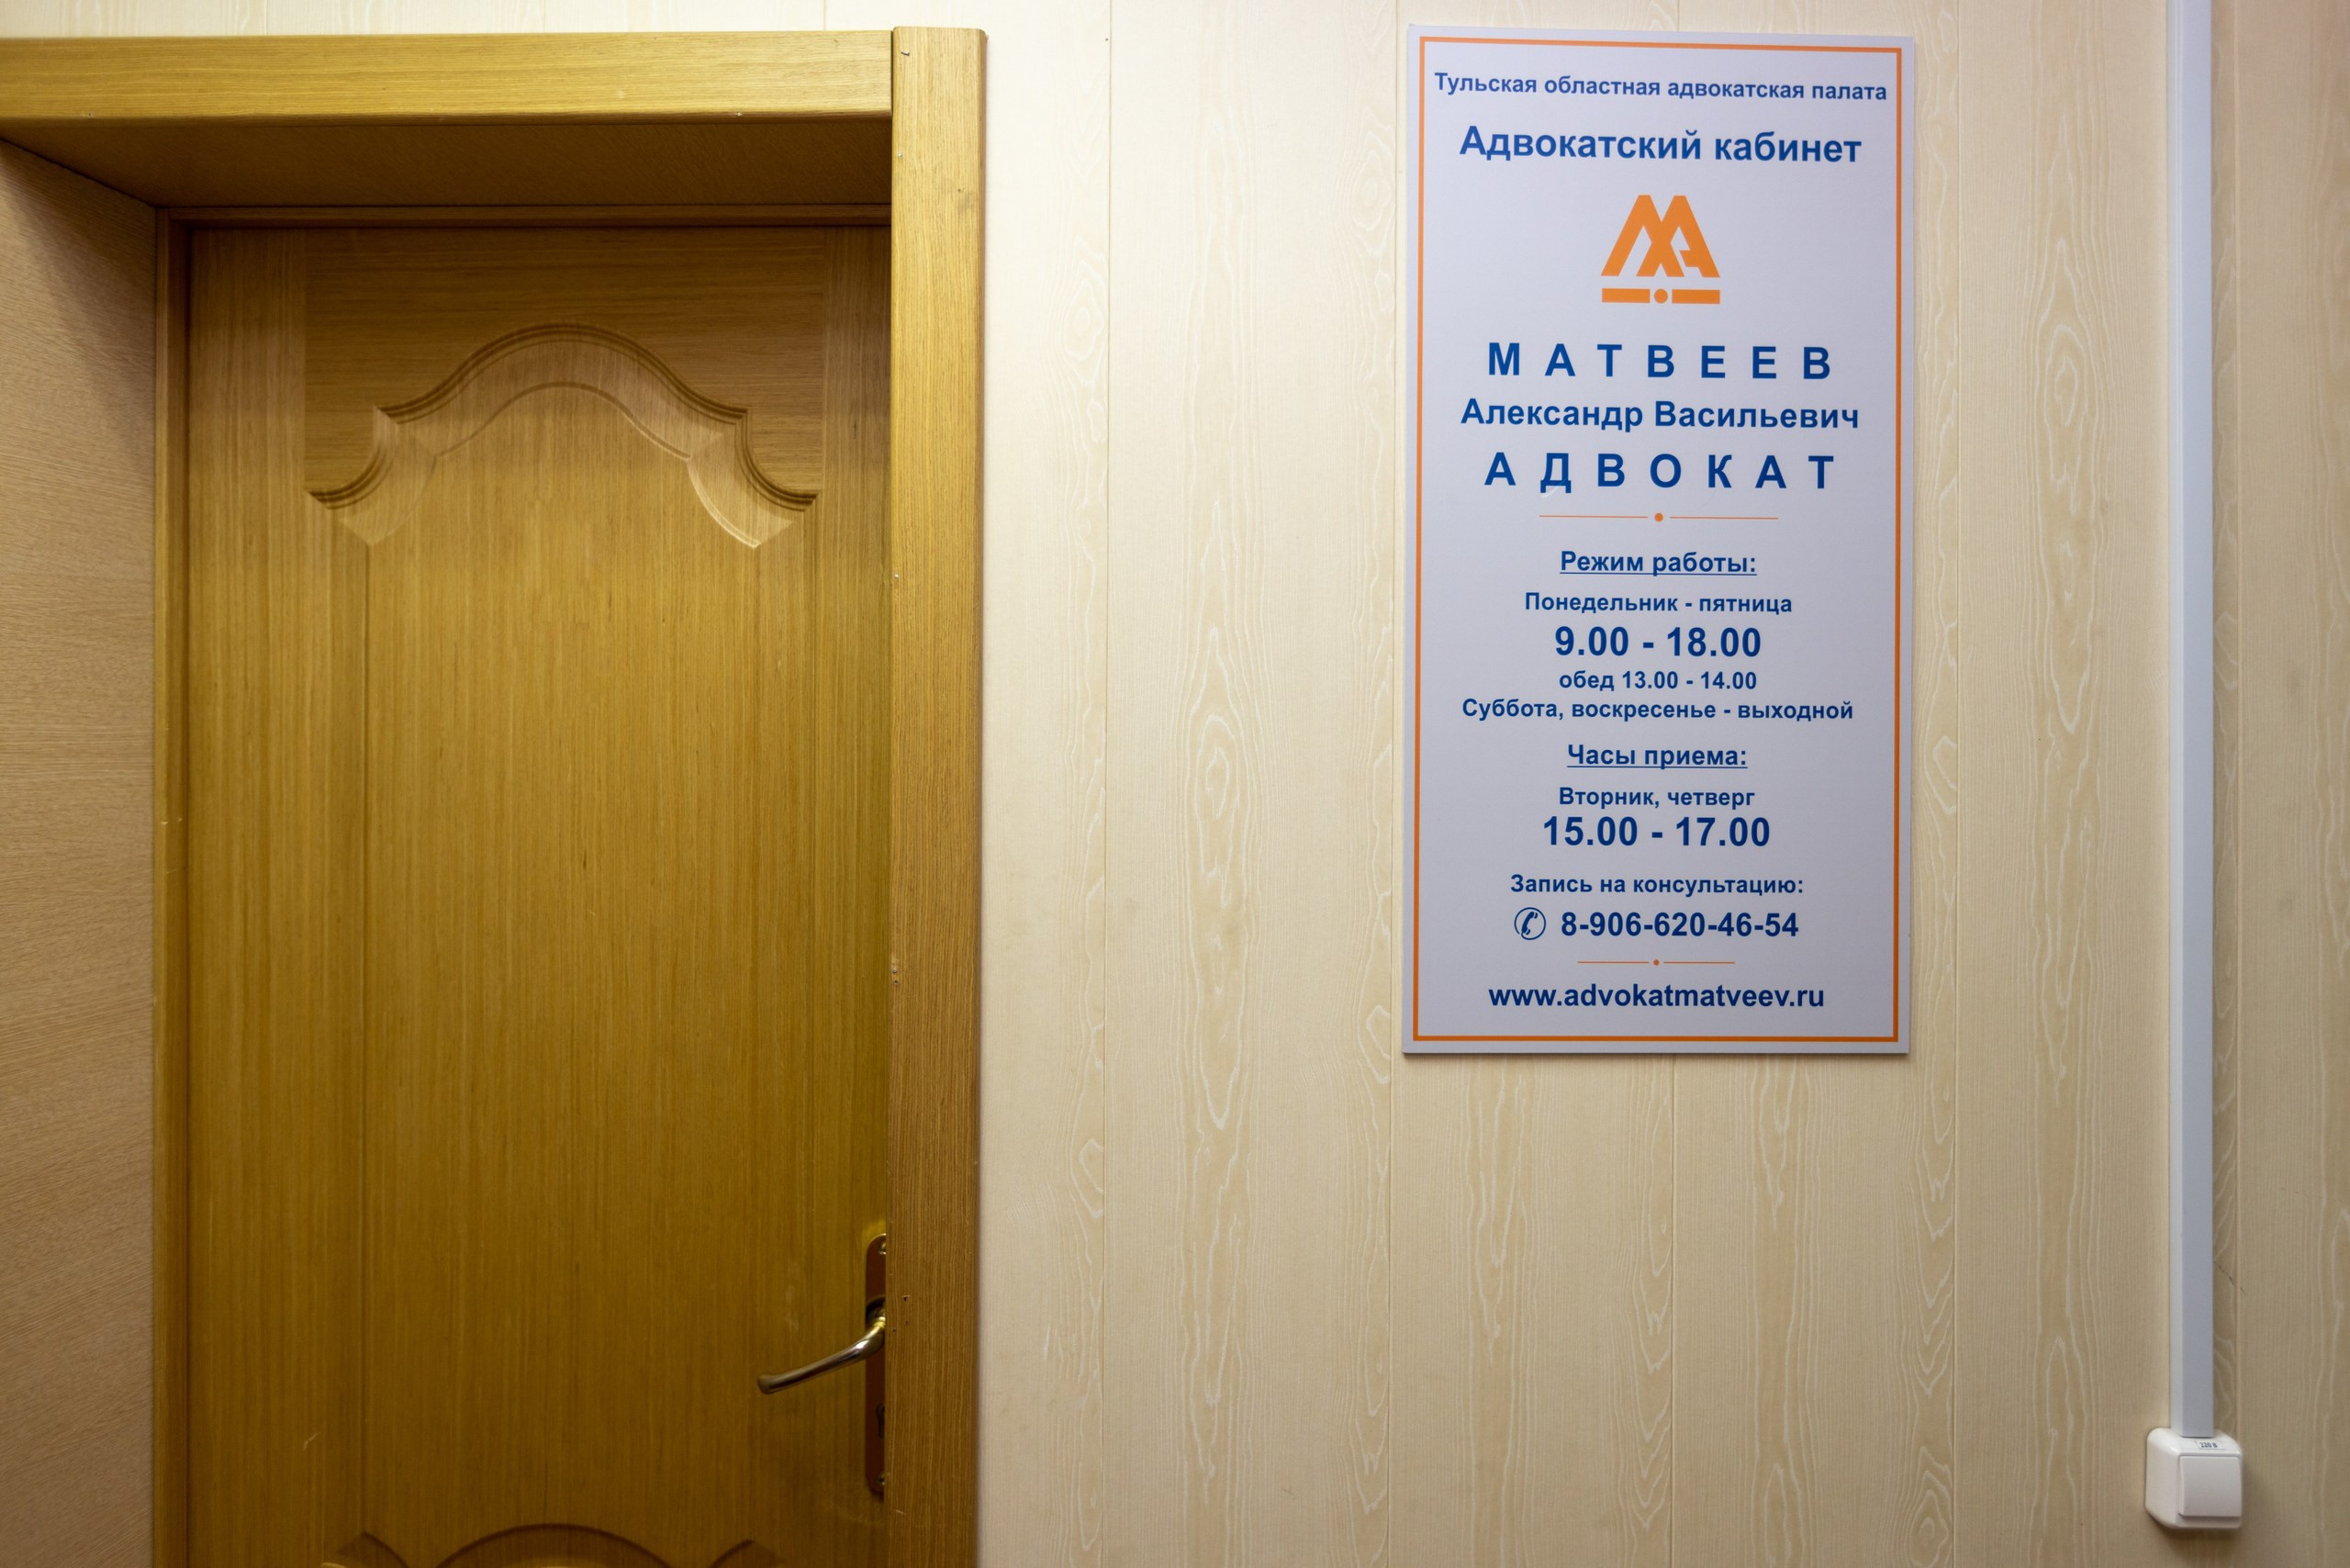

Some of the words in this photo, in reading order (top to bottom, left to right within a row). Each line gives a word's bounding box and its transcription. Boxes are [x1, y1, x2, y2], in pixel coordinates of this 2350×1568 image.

[1435, 73, 1536, 95] Тульская
[1545, 76, 1660, 95] областная
[1668, 83, 1804, 99] адвокатская
[1813, 86, 1886, 100] палата
[1460, 126, 1700, 161] Адвокатский
[1716, 131, 1862, 162] кабинет
[1489, 342, 1830, 379] МАТВЕЕВ
[1461, 398, 1642, 432] Александр
[1656, 401, 1858, 428] Васильевич
[1484, 453, 1834, 493] АДВОКАТ
[1560, 551, 1644, 575] Режим
[1652, 552, 1757, 577] работы:
[1526, 592, 1678, 613] Понедельник
[1700, 599, 1792, 615] пятница
[1555, 626, 1628, 655] 9.00
[1668, 627, 1761, 657] 18.00
[1560, 670, 1614, 691] обед
[1623, 671, 1678, 689] 13.00
[1701, 671, 1756, 689] 14.00
[1463, 699, 1562, 721] Суббота,
[1572, 704, 1716, 722] воскресенье
[1739, 701, 1852, 722] выходной
[1567, 745, 1636, 767] Часы
[1644, 750, 1748, 769] приема:
[1560, 787, 1659, 810] Вторник,
[1668, 792, 1755, 810] четверг
[1544, 816, 1638, 846] 15.00
[1676, 817, 1770, 846] 17.00
[1511, 874, 1592, 892] Запись
[1601, 879, 1625, 892] на
[1634, 879, 1802, 897] консультацию:
[1561, 912, 1798, 937] 8-906-620-46-54
[1488, 983, 1824, 1007] www.advokatmatveev.ru
